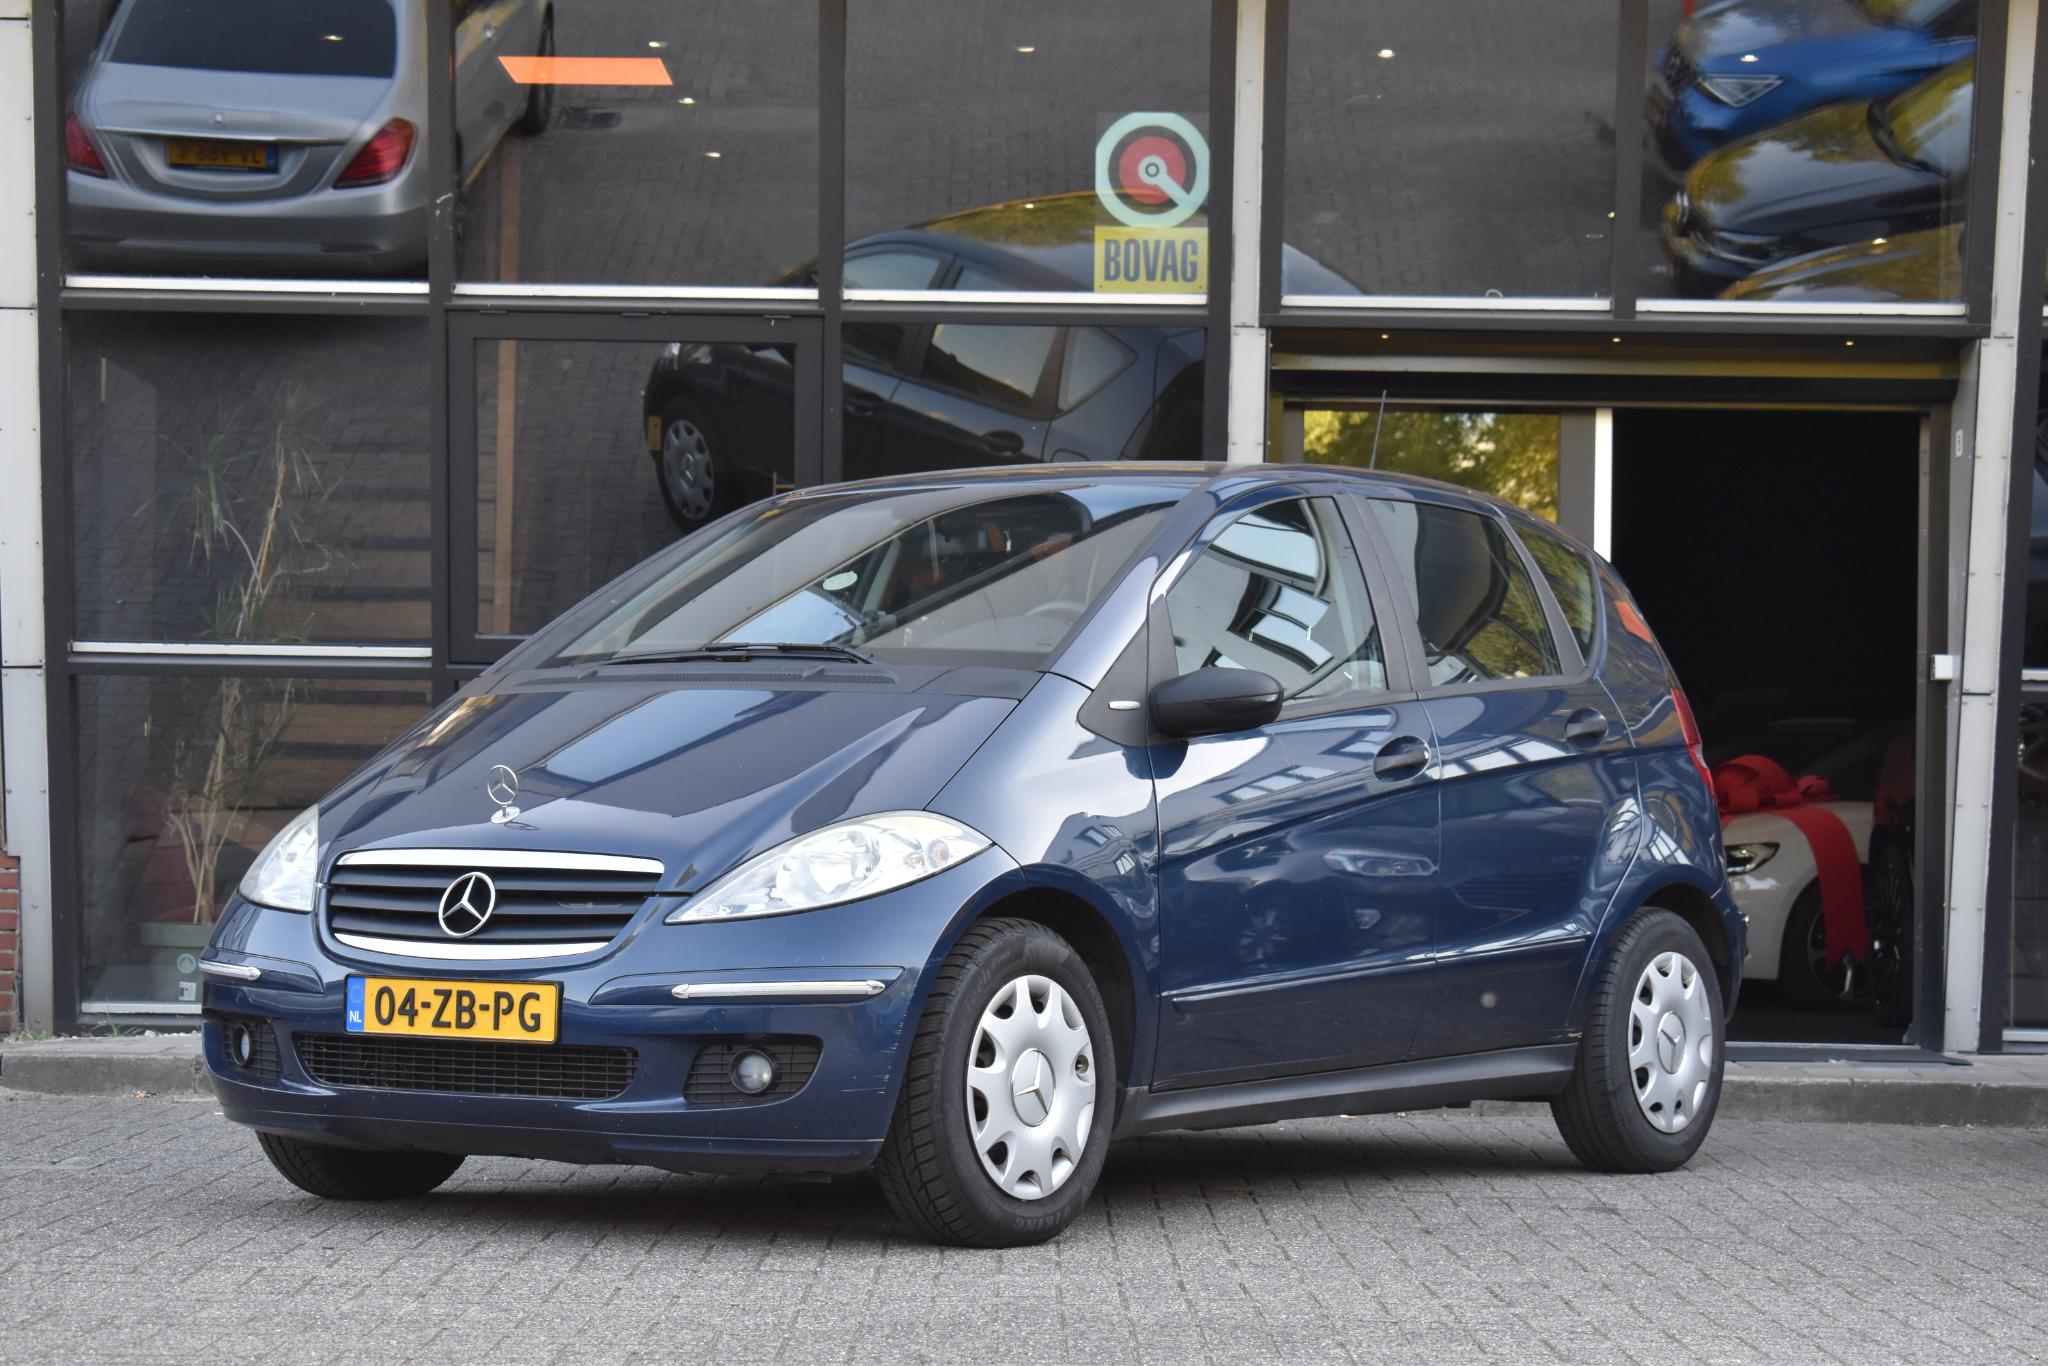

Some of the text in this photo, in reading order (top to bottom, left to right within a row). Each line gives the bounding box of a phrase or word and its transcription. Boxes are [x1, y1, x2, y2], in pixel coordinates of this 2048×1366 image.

[1104, 239, 1198, 283] BOVAG
[349, 1010, 362, 1023] NL
[375, 986, 541, 1033] 04-ZB-PG
[1014, 1205, 1072, 1231] VIKING
